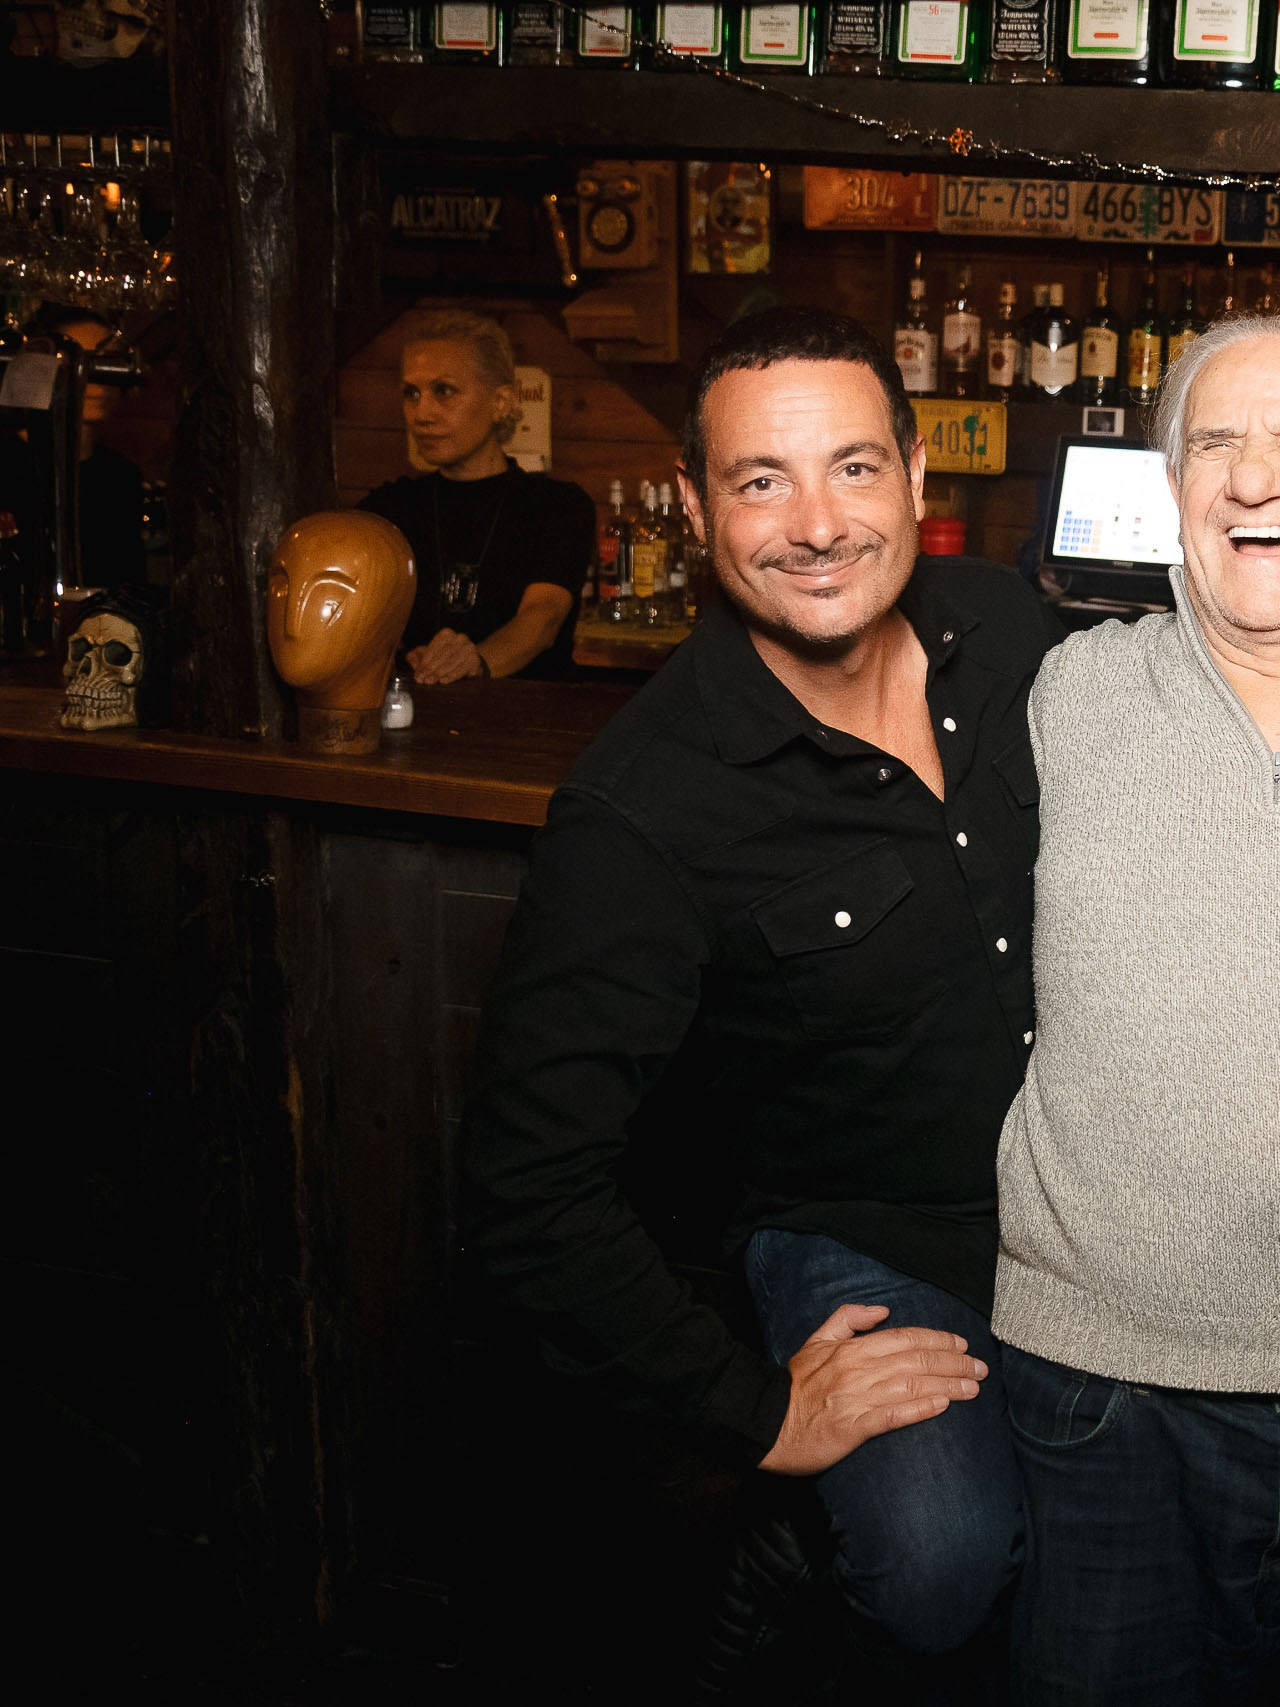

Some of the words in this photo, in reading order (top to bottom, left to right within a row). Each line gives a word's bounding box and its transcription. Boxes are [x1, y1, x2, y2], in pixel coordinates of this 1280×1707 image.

[837, 16, 874, 24] WHISKEY
[391, 193, 502, 228] ALCATRAZ
[1084, 184, 1137, 223] 466
[1158, 187, 1212, 226] BYS
